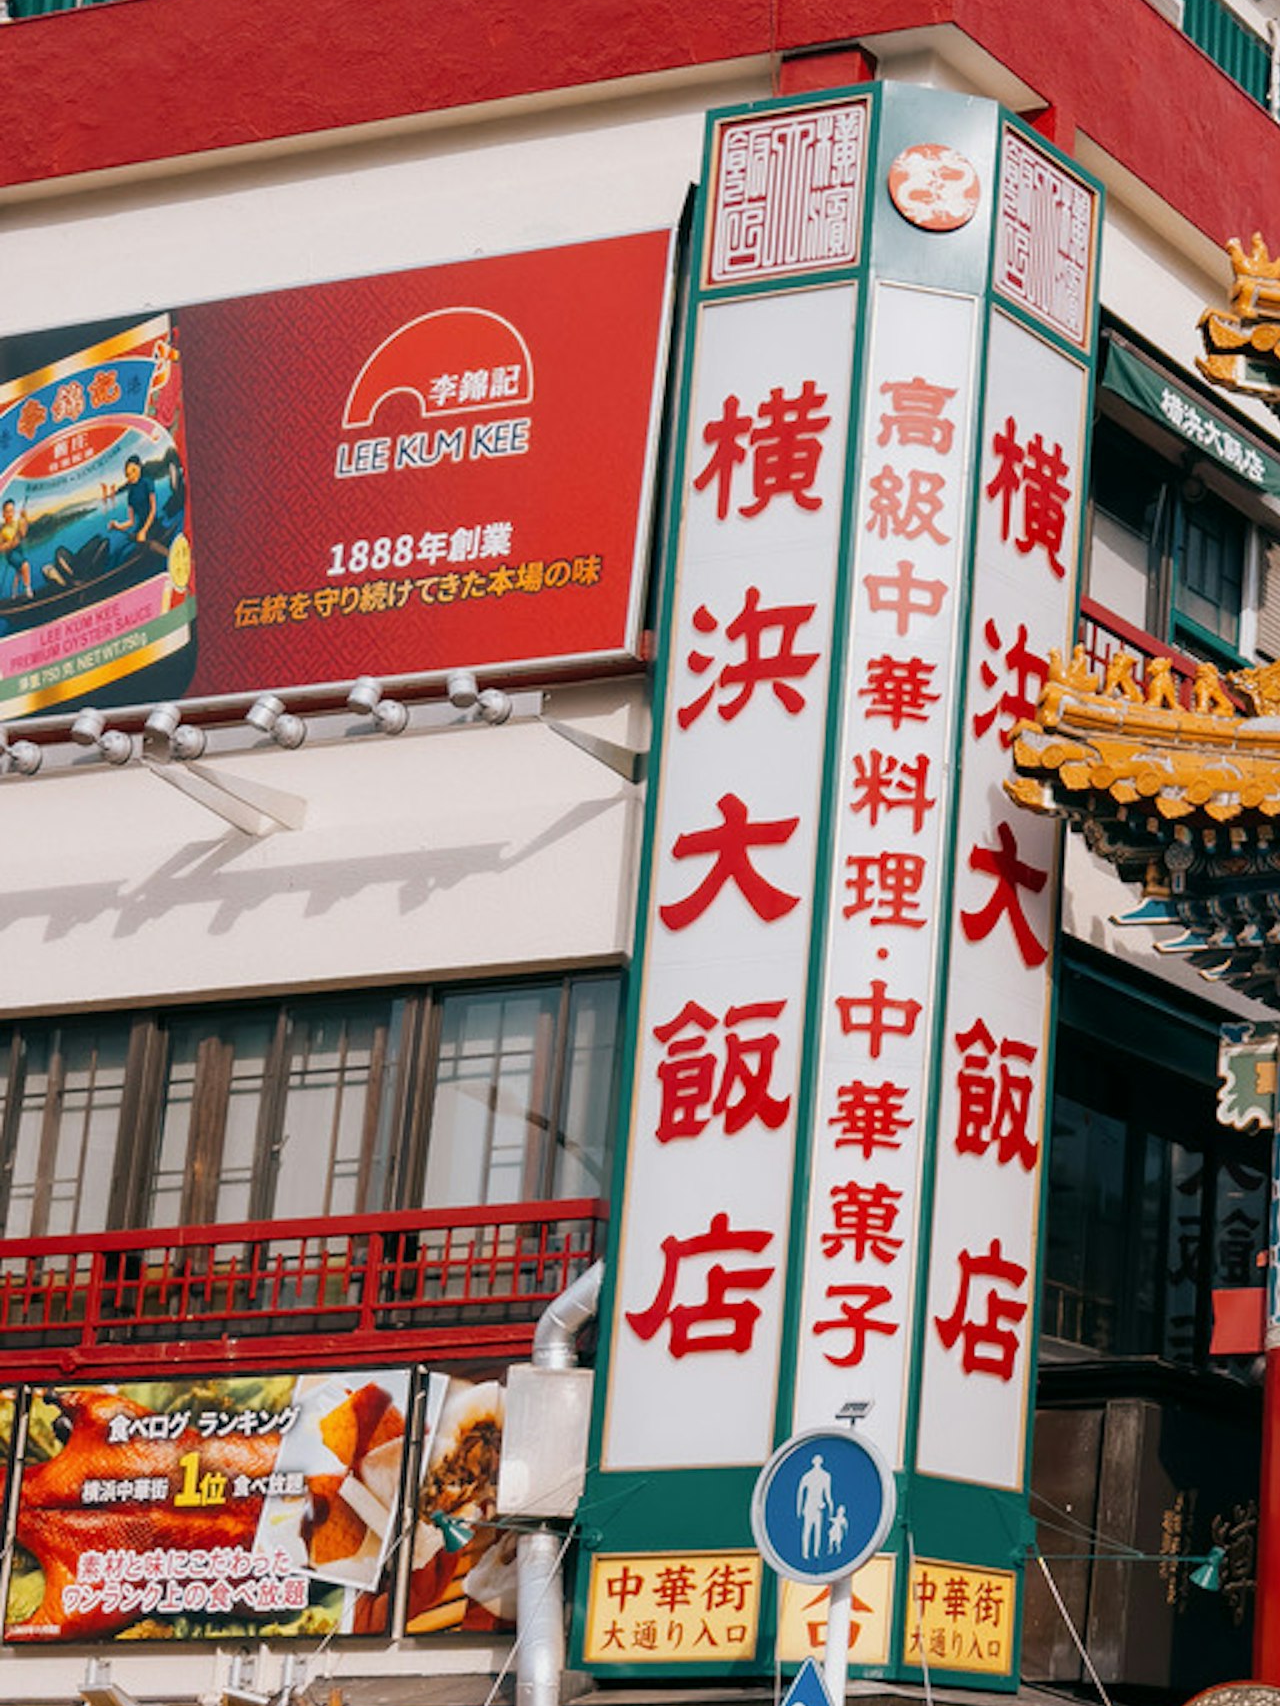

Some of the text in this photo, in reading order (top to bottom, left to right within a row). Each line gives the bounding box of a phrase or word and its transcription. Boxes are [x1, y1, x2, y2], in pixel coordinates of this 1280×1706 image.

[429, 365, 520, 408] 李錦記
[335, 419, 531, 479] LEE KUM KEE
[326, 522, 512, 577] 1888年創業
[233, 555, 601, 629] 伝統を守り続けてきた本場の味
[40, 603, 121, 646] LEE KUM KEE
[62, 623, 113, 653] OYSTER
[115, 603, 153, 631] SAUCE
[625, 380, 831, 1359] 横浜大飯店
[935, 415, 1073, 1382] 横浜大飯店
[108, 1407, 301, 1443] 食べログ ランキング
[174, 1450, 228, 1508] 1位
[77, 1544, 293, 1582] 素材と味にこだわった
[62, 1574, 310, 1613] ワンランク上の食べ放題
[605, 1564, 755, 1615] 中華街
[912, 1570, 1005, 1630] 中華街
[601, 1619, 748, 1651] 大通り入口
[909, 1623, 1002, 1661] 大通り入口
